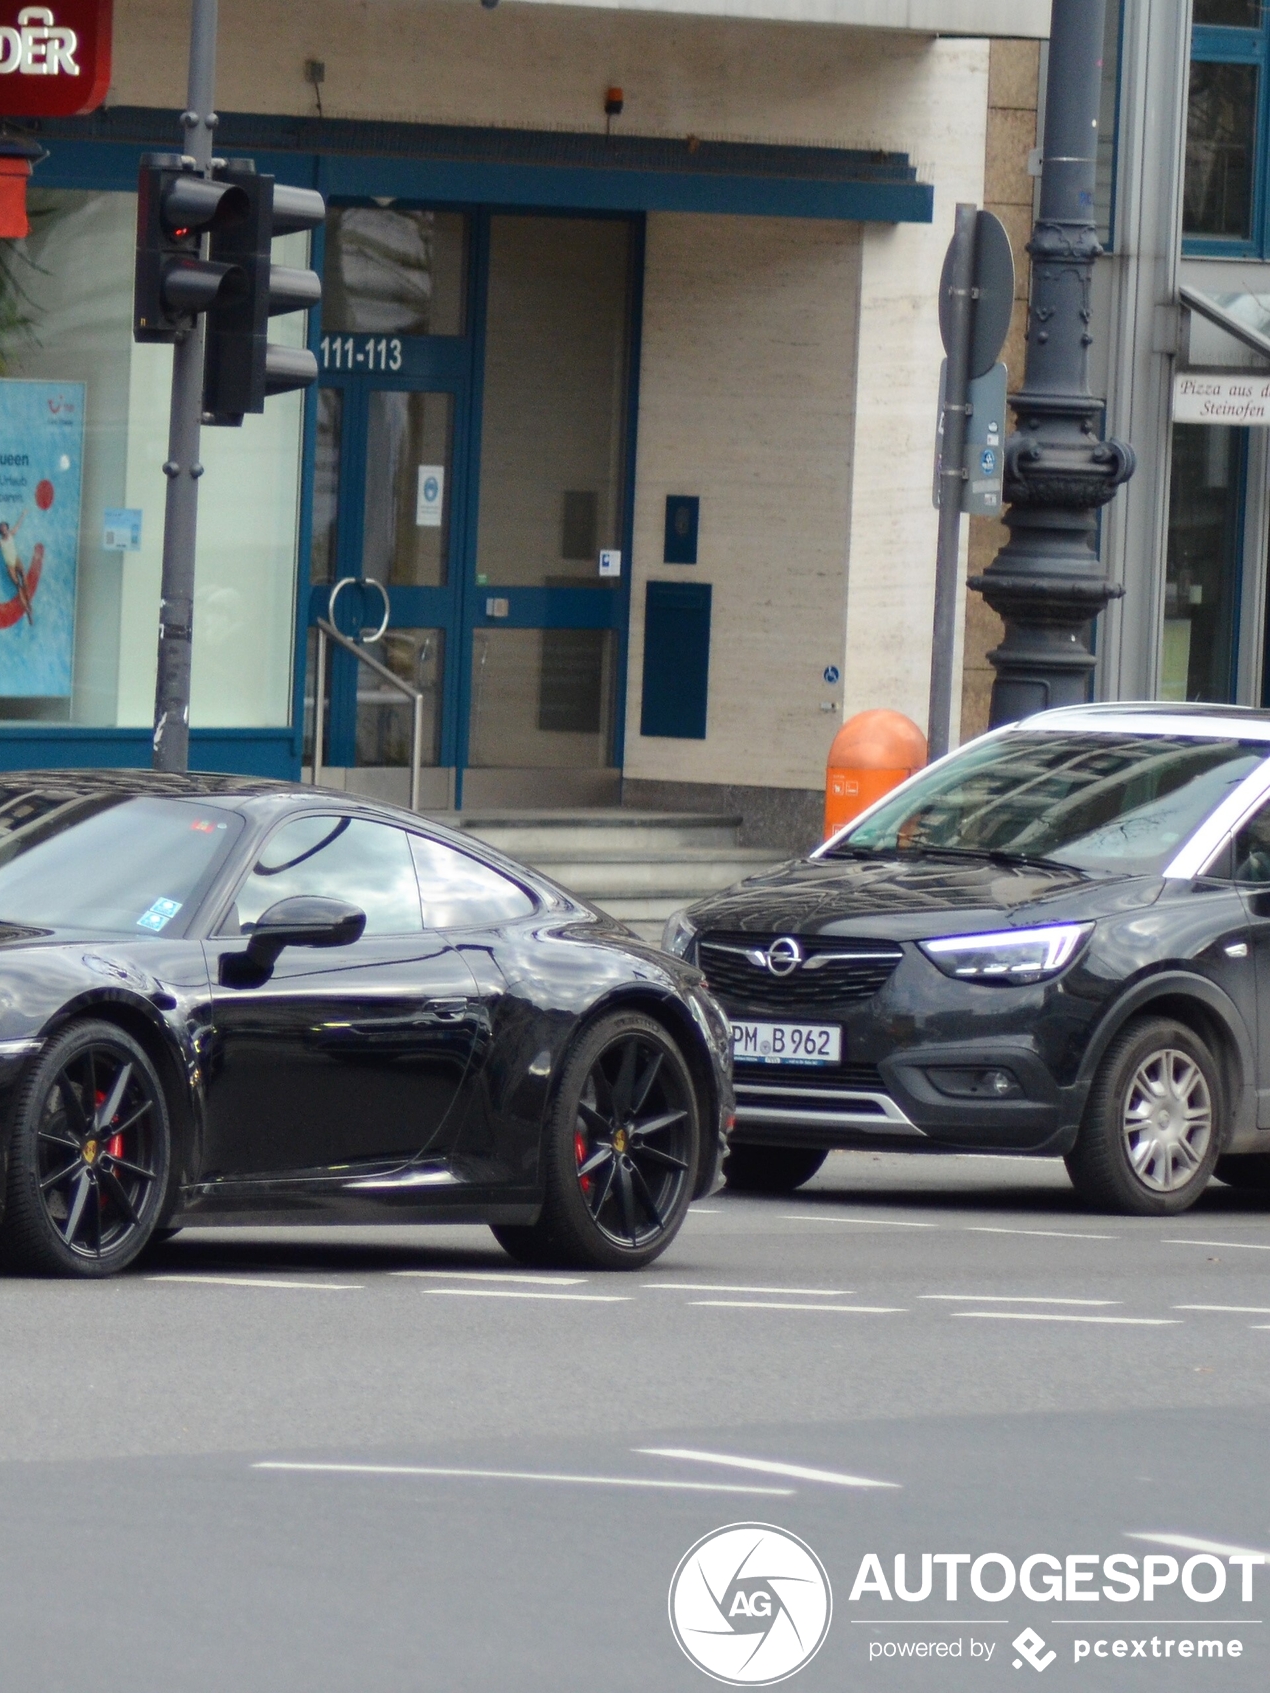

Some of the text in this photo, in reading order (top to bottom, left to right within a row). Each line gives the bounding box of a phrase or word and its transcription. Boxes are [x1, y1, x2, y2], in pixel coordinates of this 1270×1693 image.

[320, 336, 402, 370] 111-113
[1180, 380, 1221, 396] Pizza
[1229, 385, 1254, 397] aus
[1199, 401, 1265, 421] Steinofen
[732, 1025, 830, 1056] PM B 962
